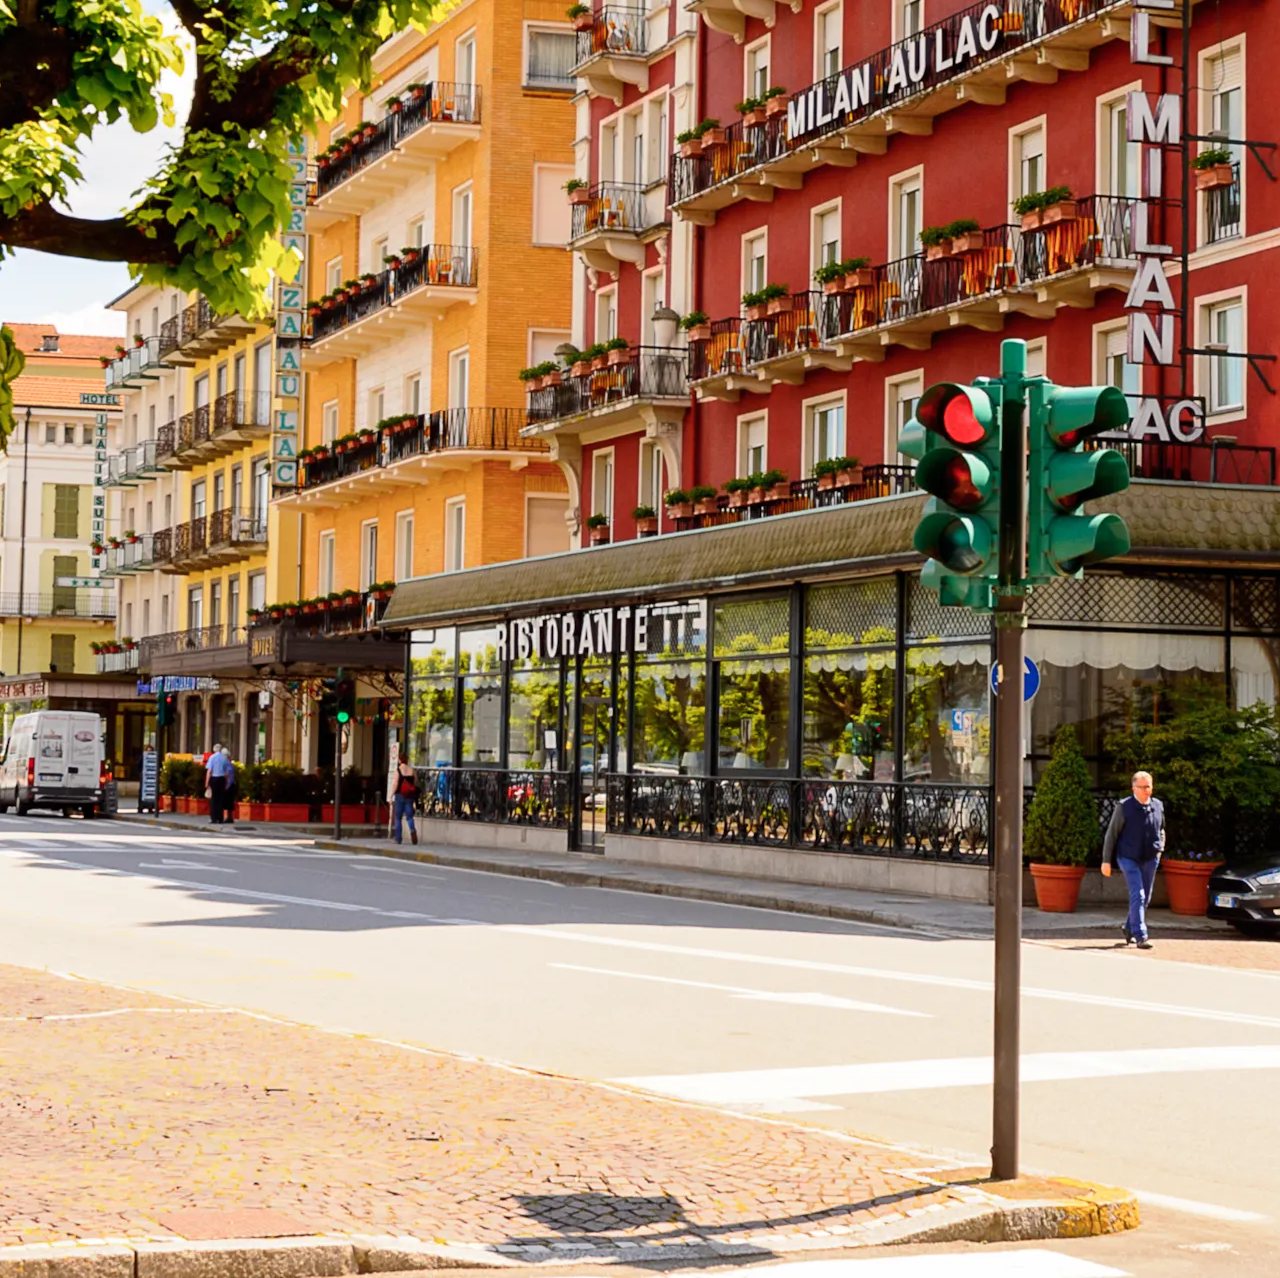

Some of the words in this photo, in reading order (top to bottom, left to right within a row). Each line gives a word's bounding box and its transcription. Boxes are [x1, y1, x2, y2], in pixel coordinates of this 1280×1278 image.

[787, 63, 870, 141] MILAN
[888, 34, 926, 94] AU
[935, 4, 999, 72] LAC
[1125, 90, 1180, 365] MILAN
[82, 394, 118, 405] HOTEL
[280, 351, 298, 395] AU
[95, 414, 106, 487] ITALIE
[277, 412, 295, 483] LAC
[1097, 397, 1204, 442] AC
[93, 495, 104, 568] SUISE
[495, 608, 649, 662] RISTORANTE
